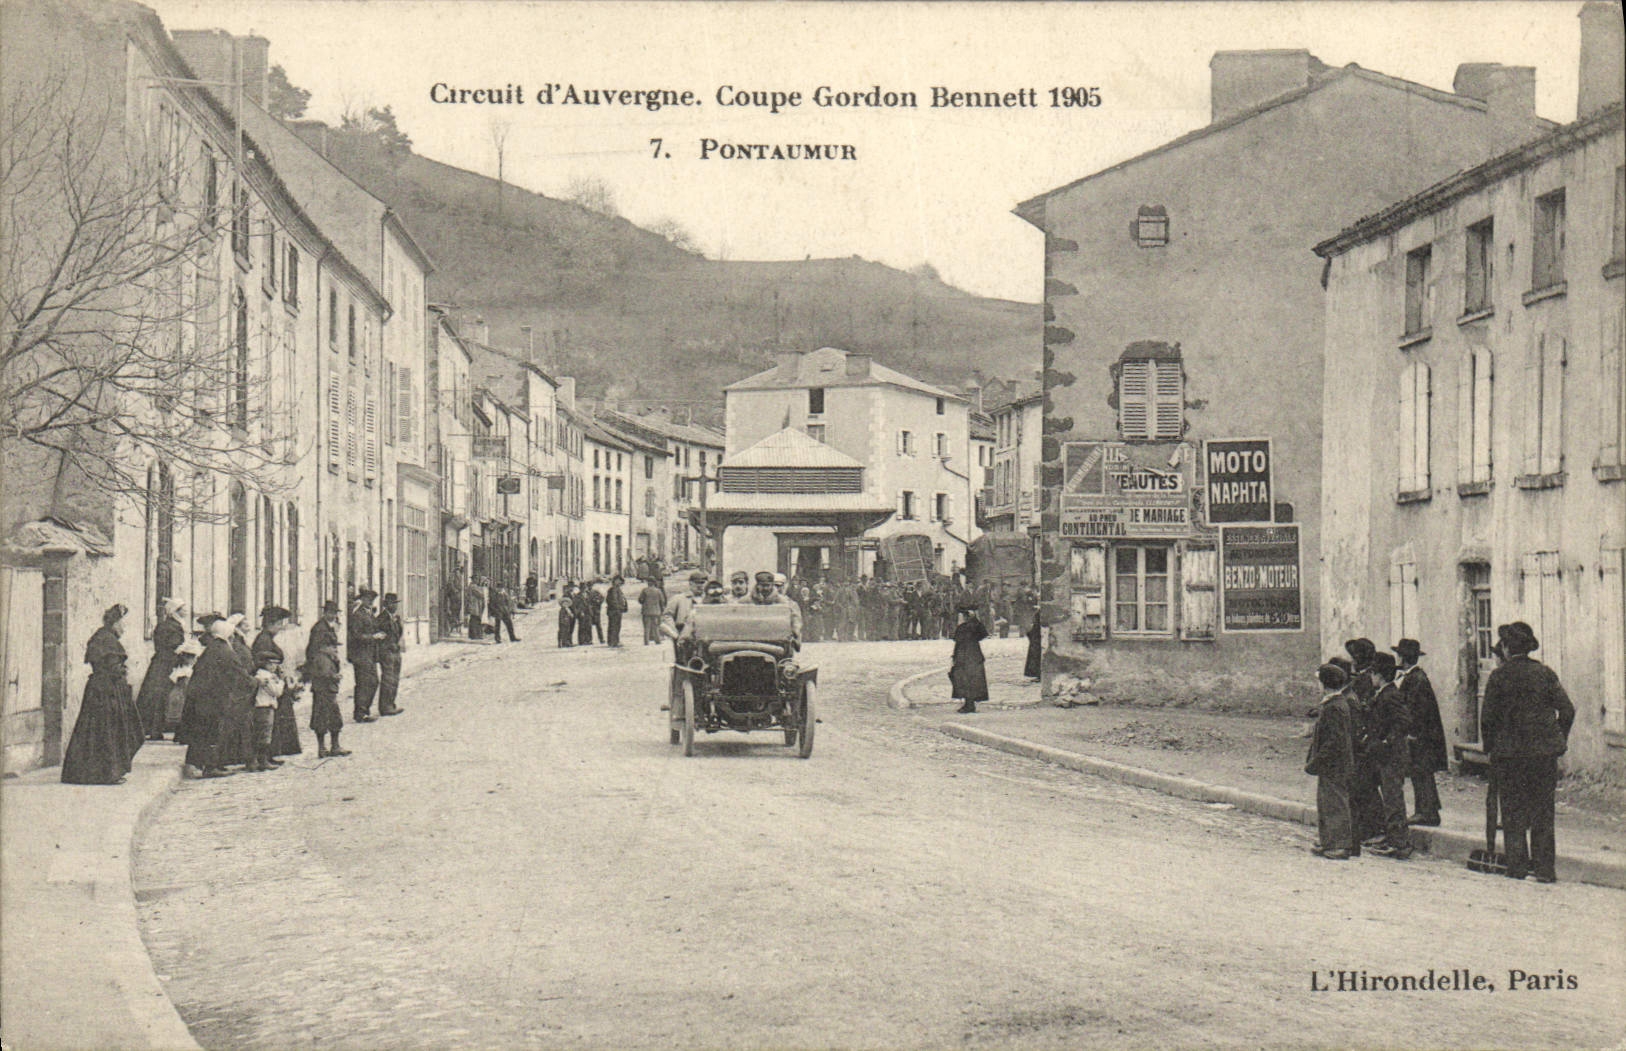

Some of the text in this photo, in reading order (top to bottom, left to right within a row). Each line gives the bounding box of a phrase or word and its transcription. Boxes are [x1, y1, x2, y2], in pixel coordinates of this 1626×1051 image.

[1210, 450, 1266, 474] MOTO
[1211, 481, 1268, 504] NAPHTA
[1143, 508, 1185, 523] MARIAGE
[1062, 522, 1127, 536] CONTINENTAL
